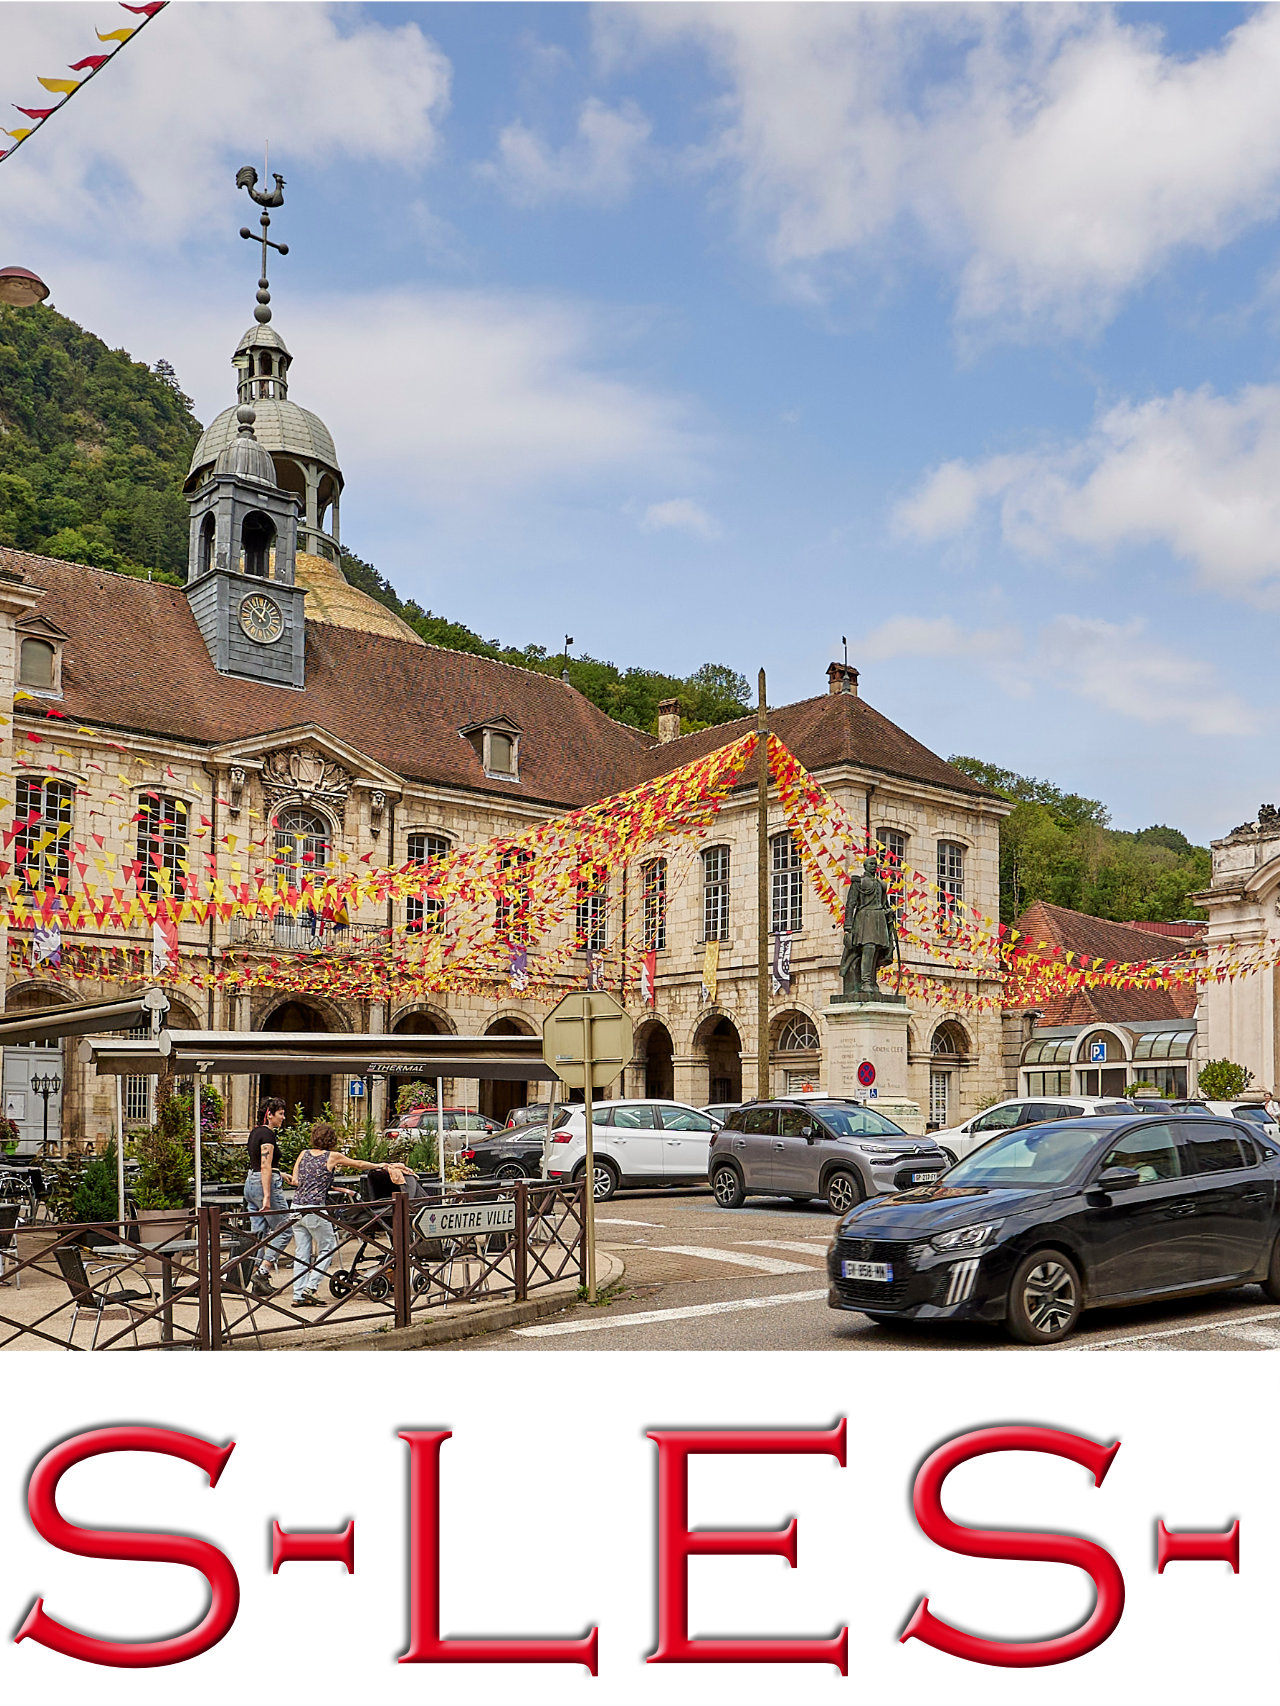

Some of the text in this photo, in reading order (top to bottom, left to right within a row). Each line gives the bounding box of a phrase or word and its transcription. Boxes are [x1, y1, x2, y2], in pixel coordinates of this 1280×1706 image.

[376, 1063, 425, 1073] THERMAL
[440, 1211, 483, 1230] CENTRE
[487, 1209, 514, 1226] VILLE
